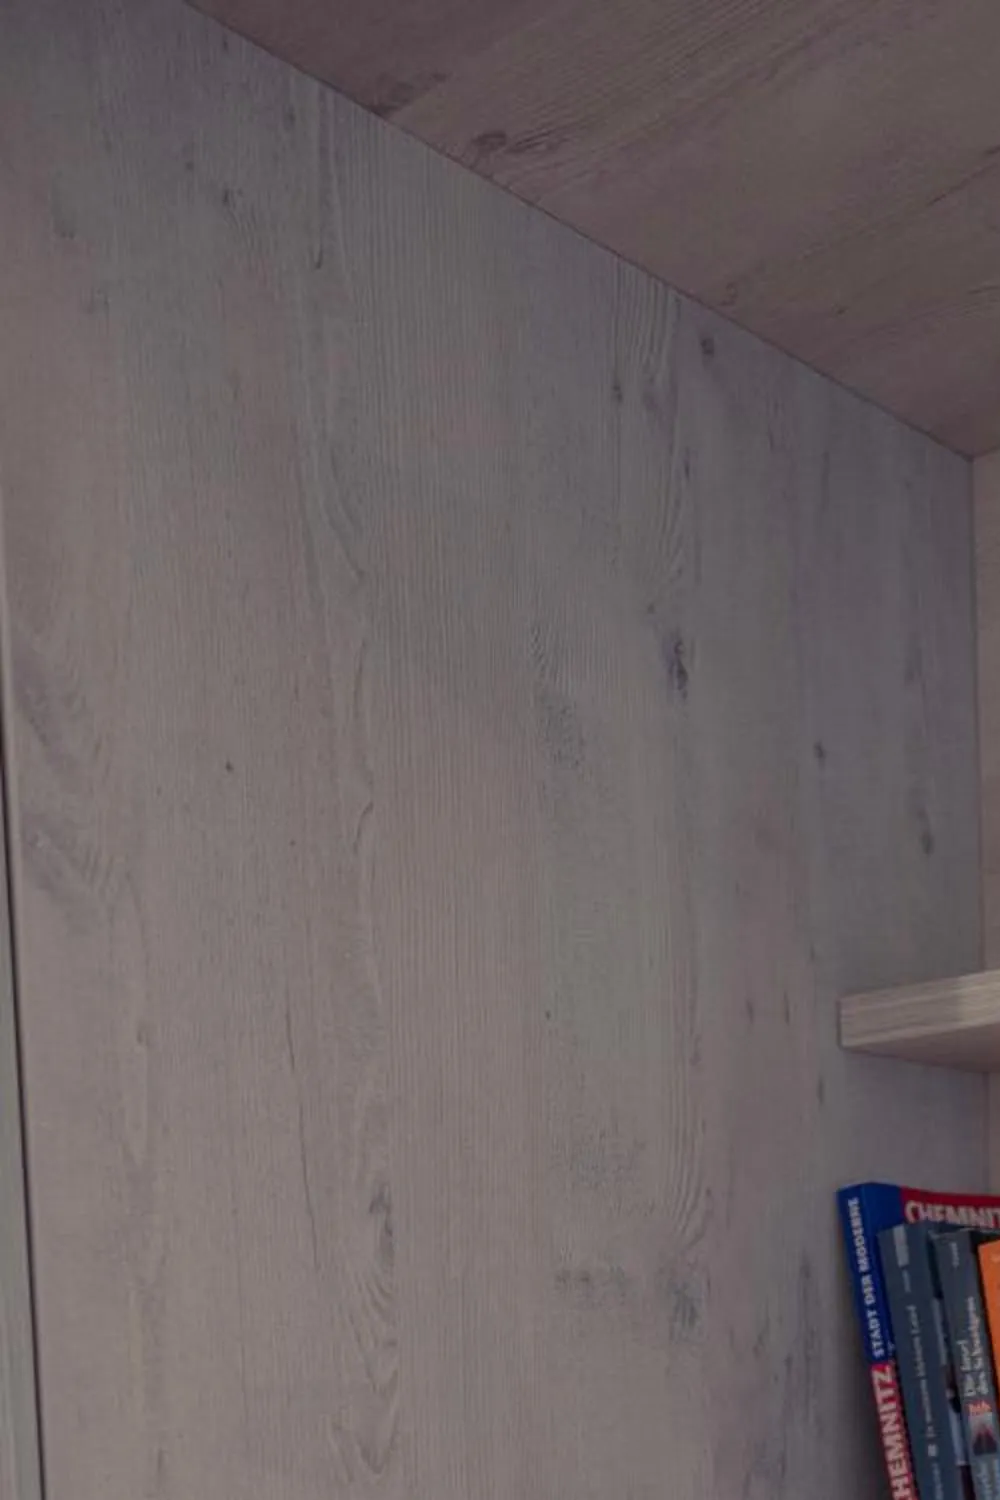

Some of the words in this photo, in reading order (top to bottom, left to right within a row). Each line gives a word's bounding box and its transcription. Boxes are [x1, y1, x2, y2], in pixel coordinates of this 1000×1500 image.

[847, 1197, 870, 1273] MODERNE
[861, 1275, 876, 1305] DER
[866, 1309, 885, 1359] STADT
